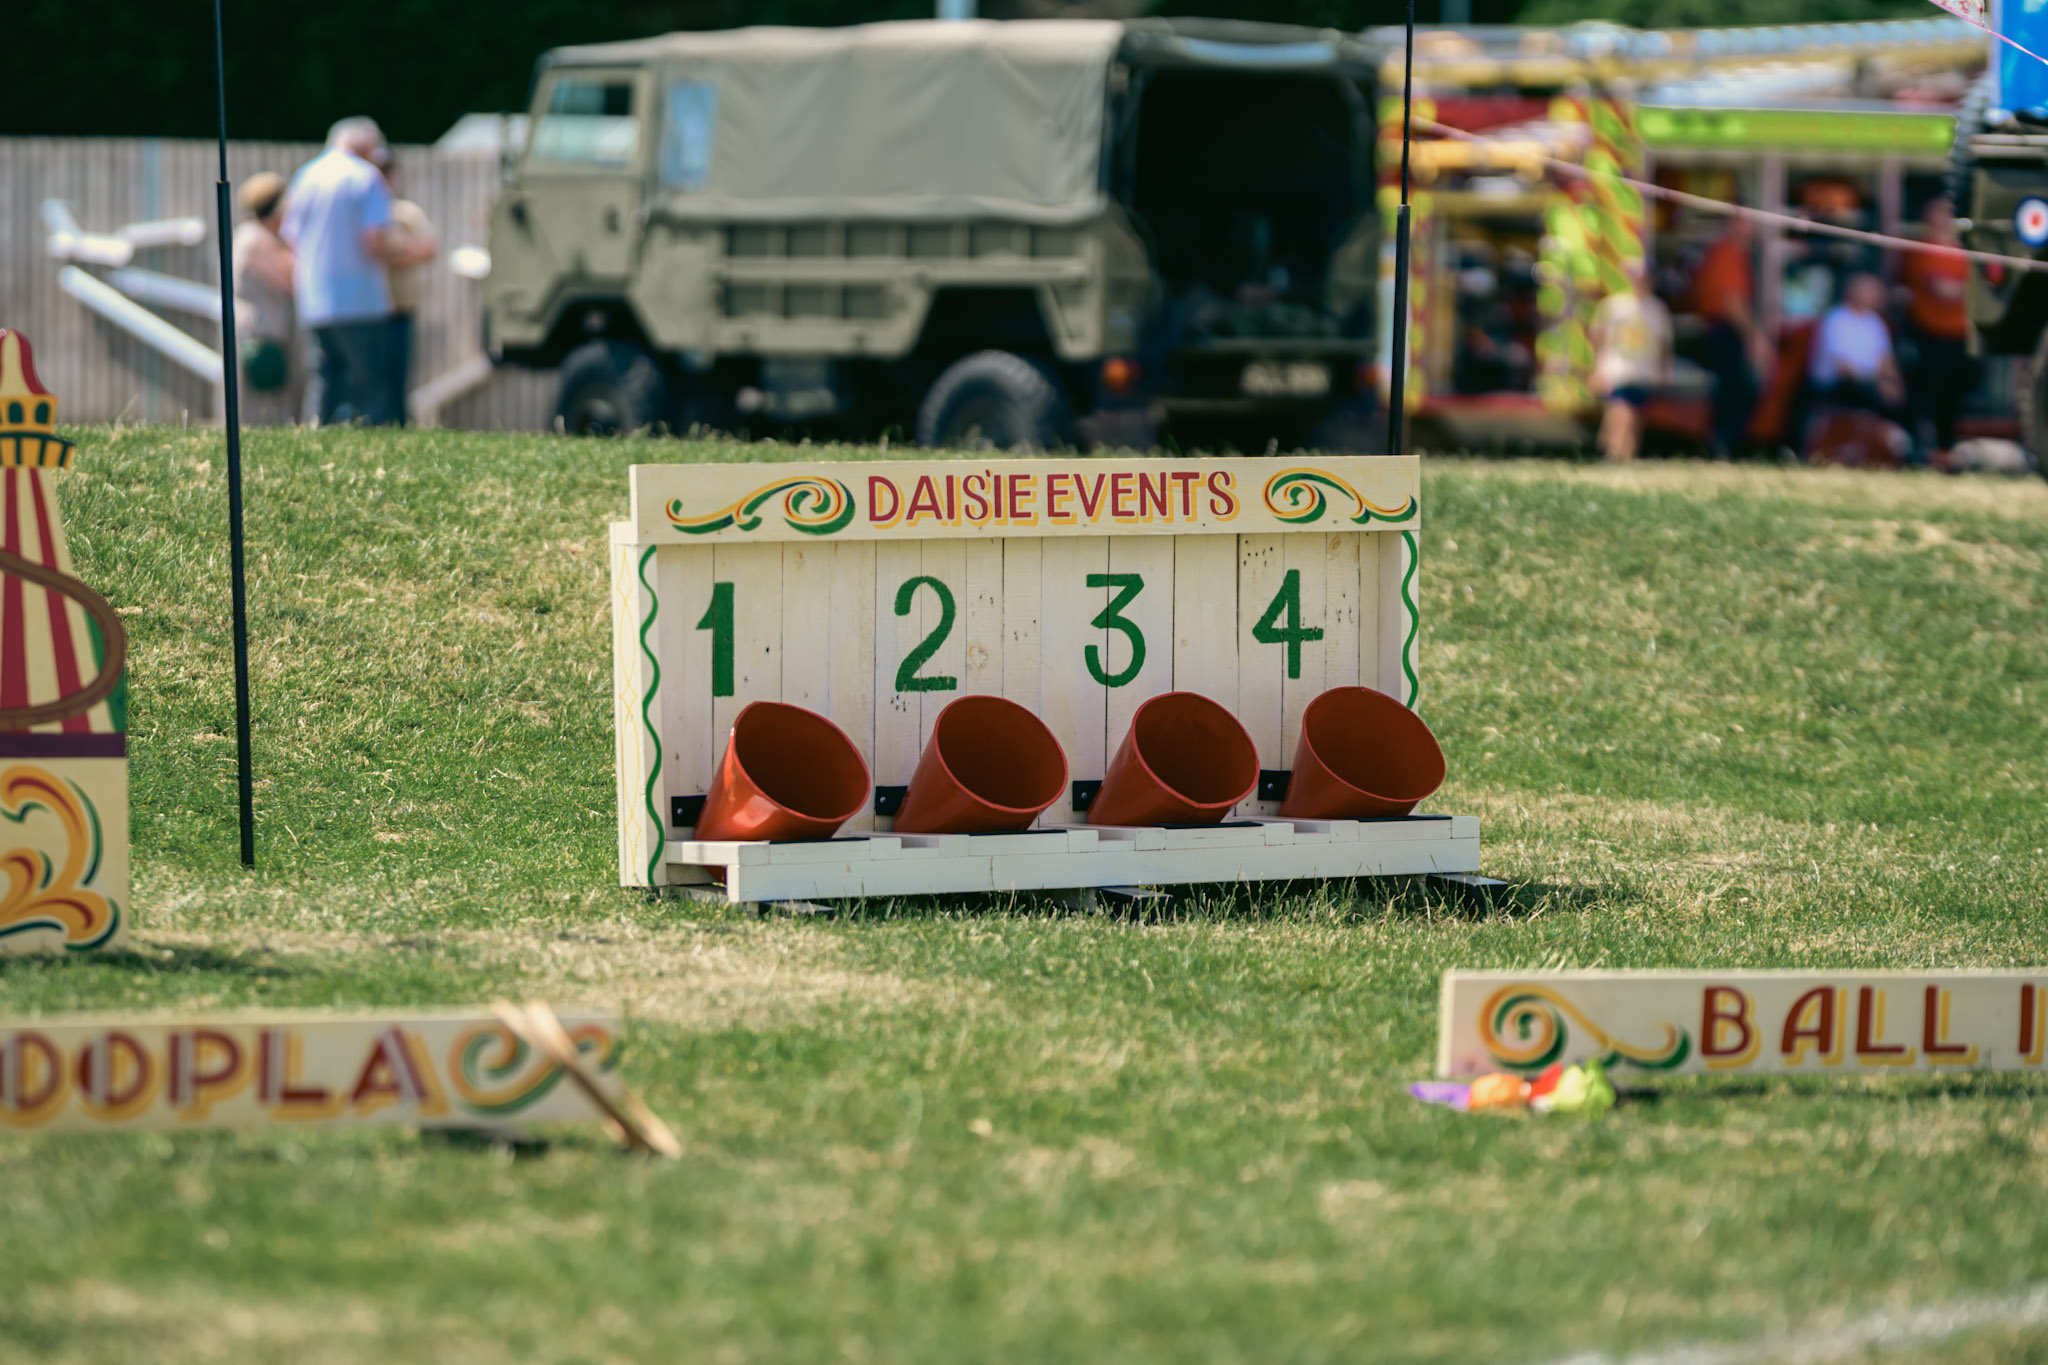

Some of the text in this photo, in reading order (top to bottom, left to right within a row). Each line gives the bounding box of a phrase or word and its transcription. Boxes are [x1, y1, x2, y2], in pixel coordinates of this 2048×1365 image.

[1047, 471, 1241, 525] EVENTS
[695, 569, 1324, 698] 1 2 3 4
[1701, 984, 1978, 1067] BALL
